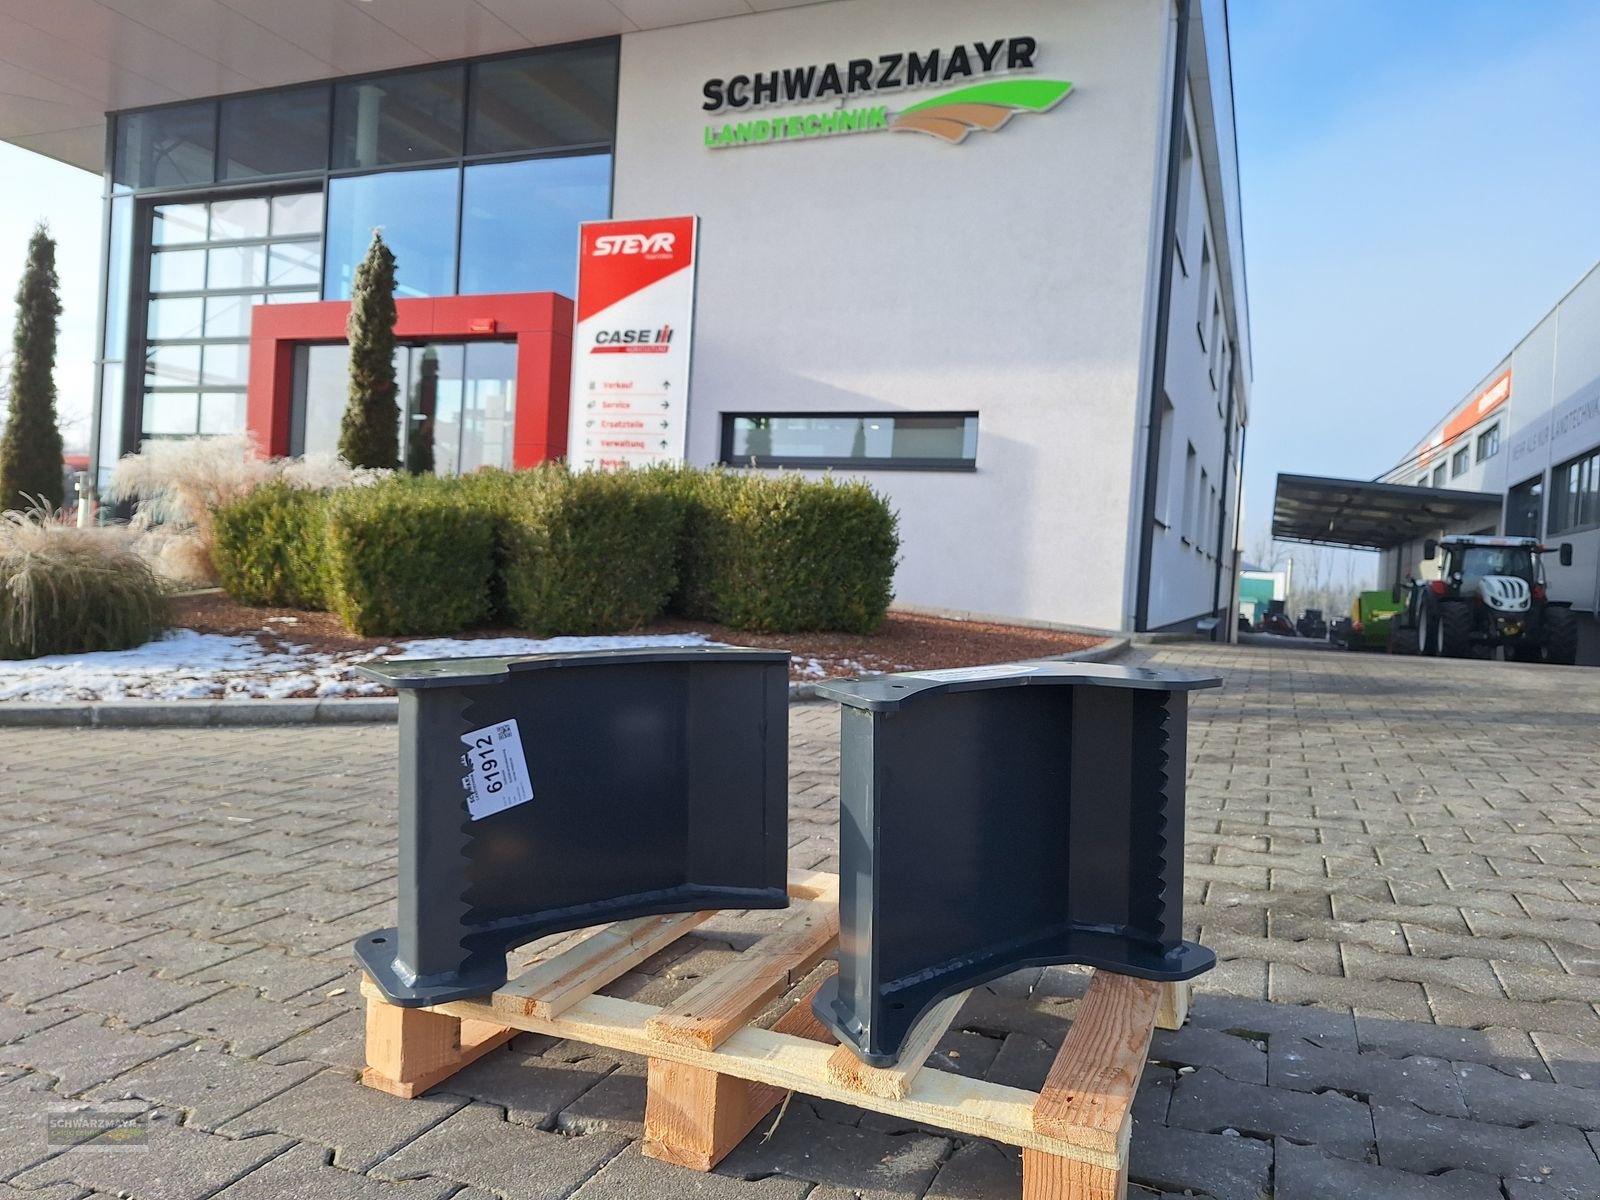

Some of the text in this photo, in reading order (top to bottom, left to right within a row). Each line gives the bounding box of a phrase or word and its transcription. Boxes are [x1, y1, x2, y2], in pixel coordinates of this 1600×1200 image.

[702, 36, 1037, 111] SCHWARZMAYR
[704, 106, 889, 147] LANDTECHNIK
[592, 232, 676, 257] STEYR
[595, 330, 651, 344] CASE
[603, 382, 633, 390] Verkauf
[602, 401, 630, 409] Service
[601, 420, 644, 428] Ersatzteile
[601, 440, 645, 449] Verwaltung
[476, 735, 503, 794] 61912
